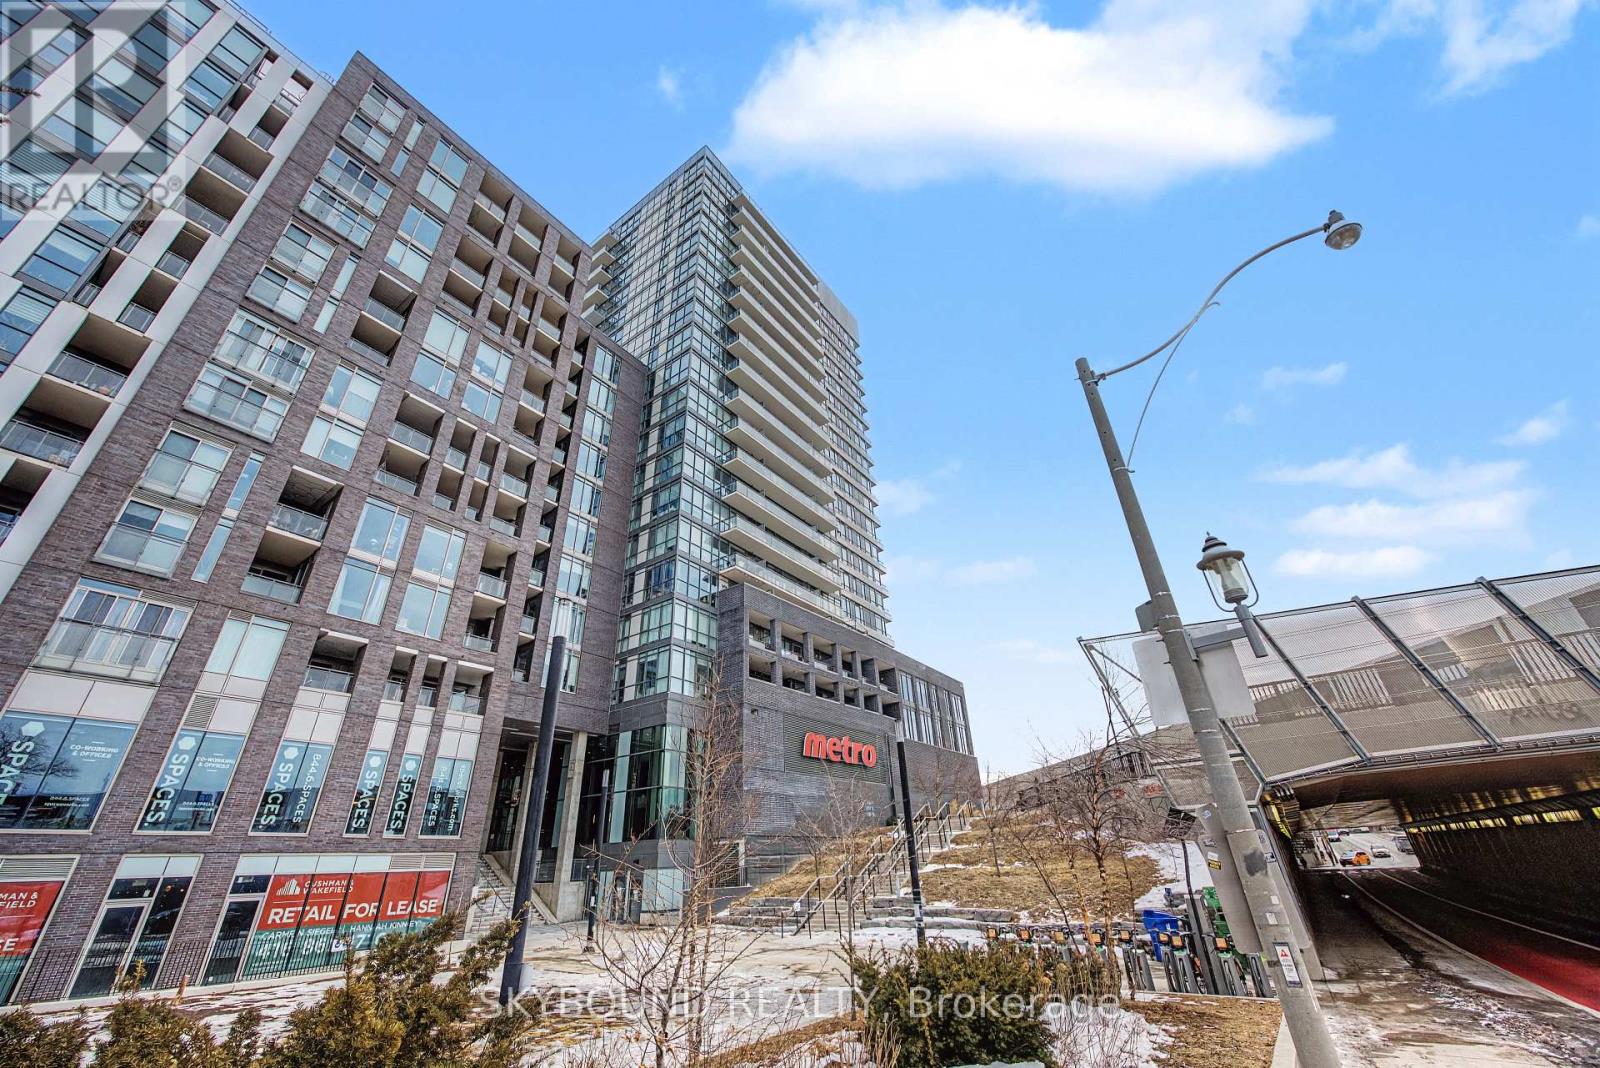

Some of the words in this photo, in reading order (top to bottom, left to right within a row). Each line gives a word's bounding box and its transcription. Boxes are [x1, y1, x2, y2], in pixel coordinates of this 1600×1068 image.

[803, 732, 877, 768] metro
[144, 753, 189, 827] SPACES.
[258, 762, 293, 829] SPACES.
[351, 770, 377, 831] SPACES.
[31, 892, 37, 900] &
[304, 879, 347, 888] CUSHMAN
[267, 904, 336, 924] RETAIL
[343, 902, 382, 918] FOR
[387, 899, 439, 916] LEASE
